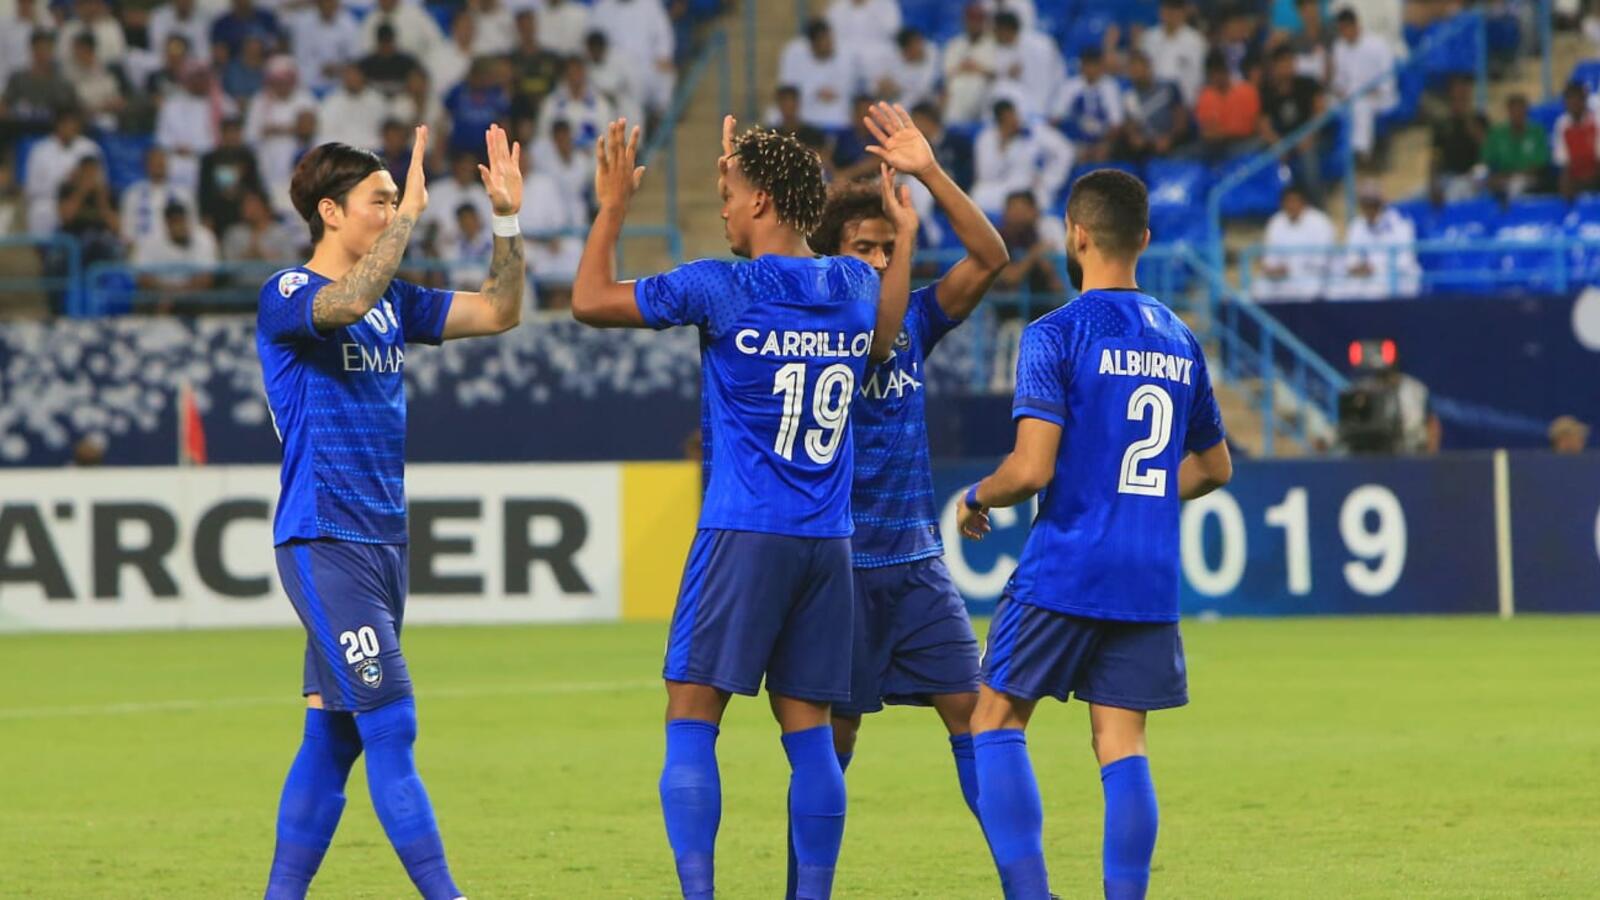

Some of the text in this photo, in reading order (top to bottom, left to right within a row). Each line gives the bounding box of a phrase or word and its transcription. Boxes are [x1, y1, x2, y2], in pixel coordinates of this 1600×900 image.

[342, 343, 405, 373] EMAA
[772, 363, 854, 464] 19
[1118, 384, 1173, 497] 2
[1180, 484, 1408, 596] 019
[340, 626, 380, 665] 20
